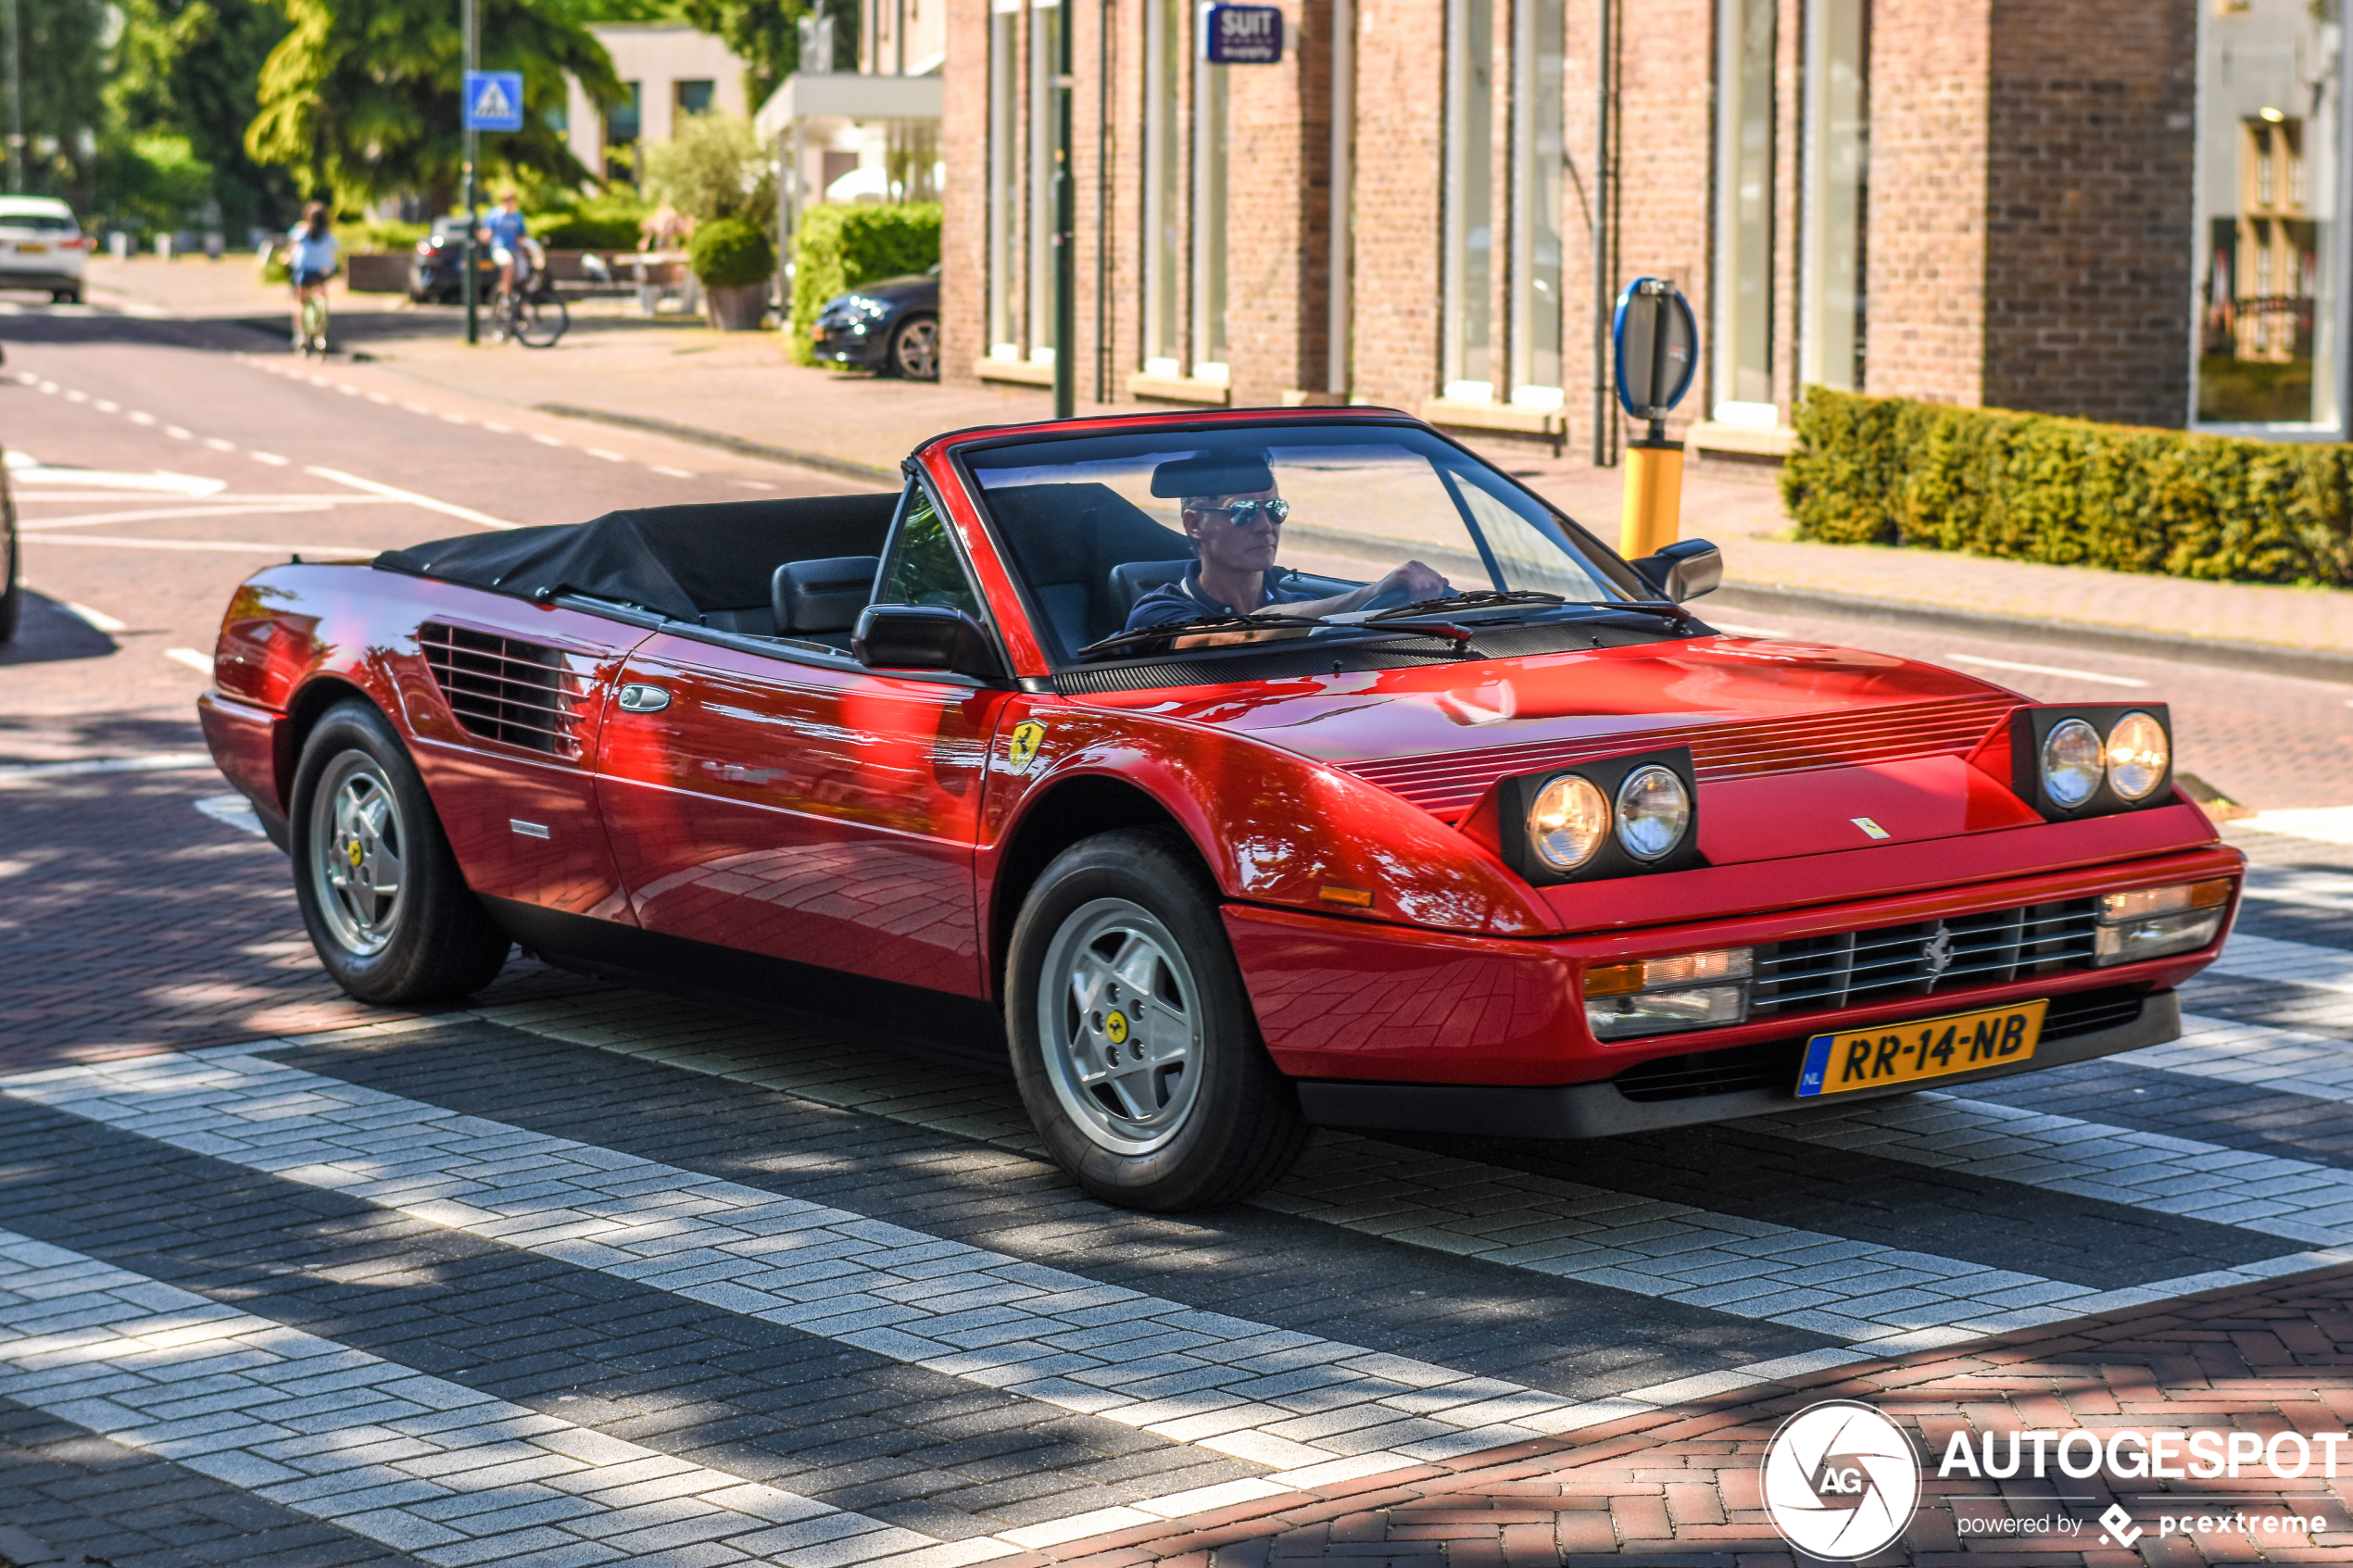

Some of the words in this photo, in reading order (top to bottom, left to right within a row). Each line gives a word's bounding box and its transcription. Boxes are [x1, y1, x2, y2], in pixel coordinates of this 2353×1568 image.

[1220, 9, 1273, 37] SUIT
[1842, 1013, 2027, 1083] RR-14-NB
[1802, 1072, 1820, 1086] NL
